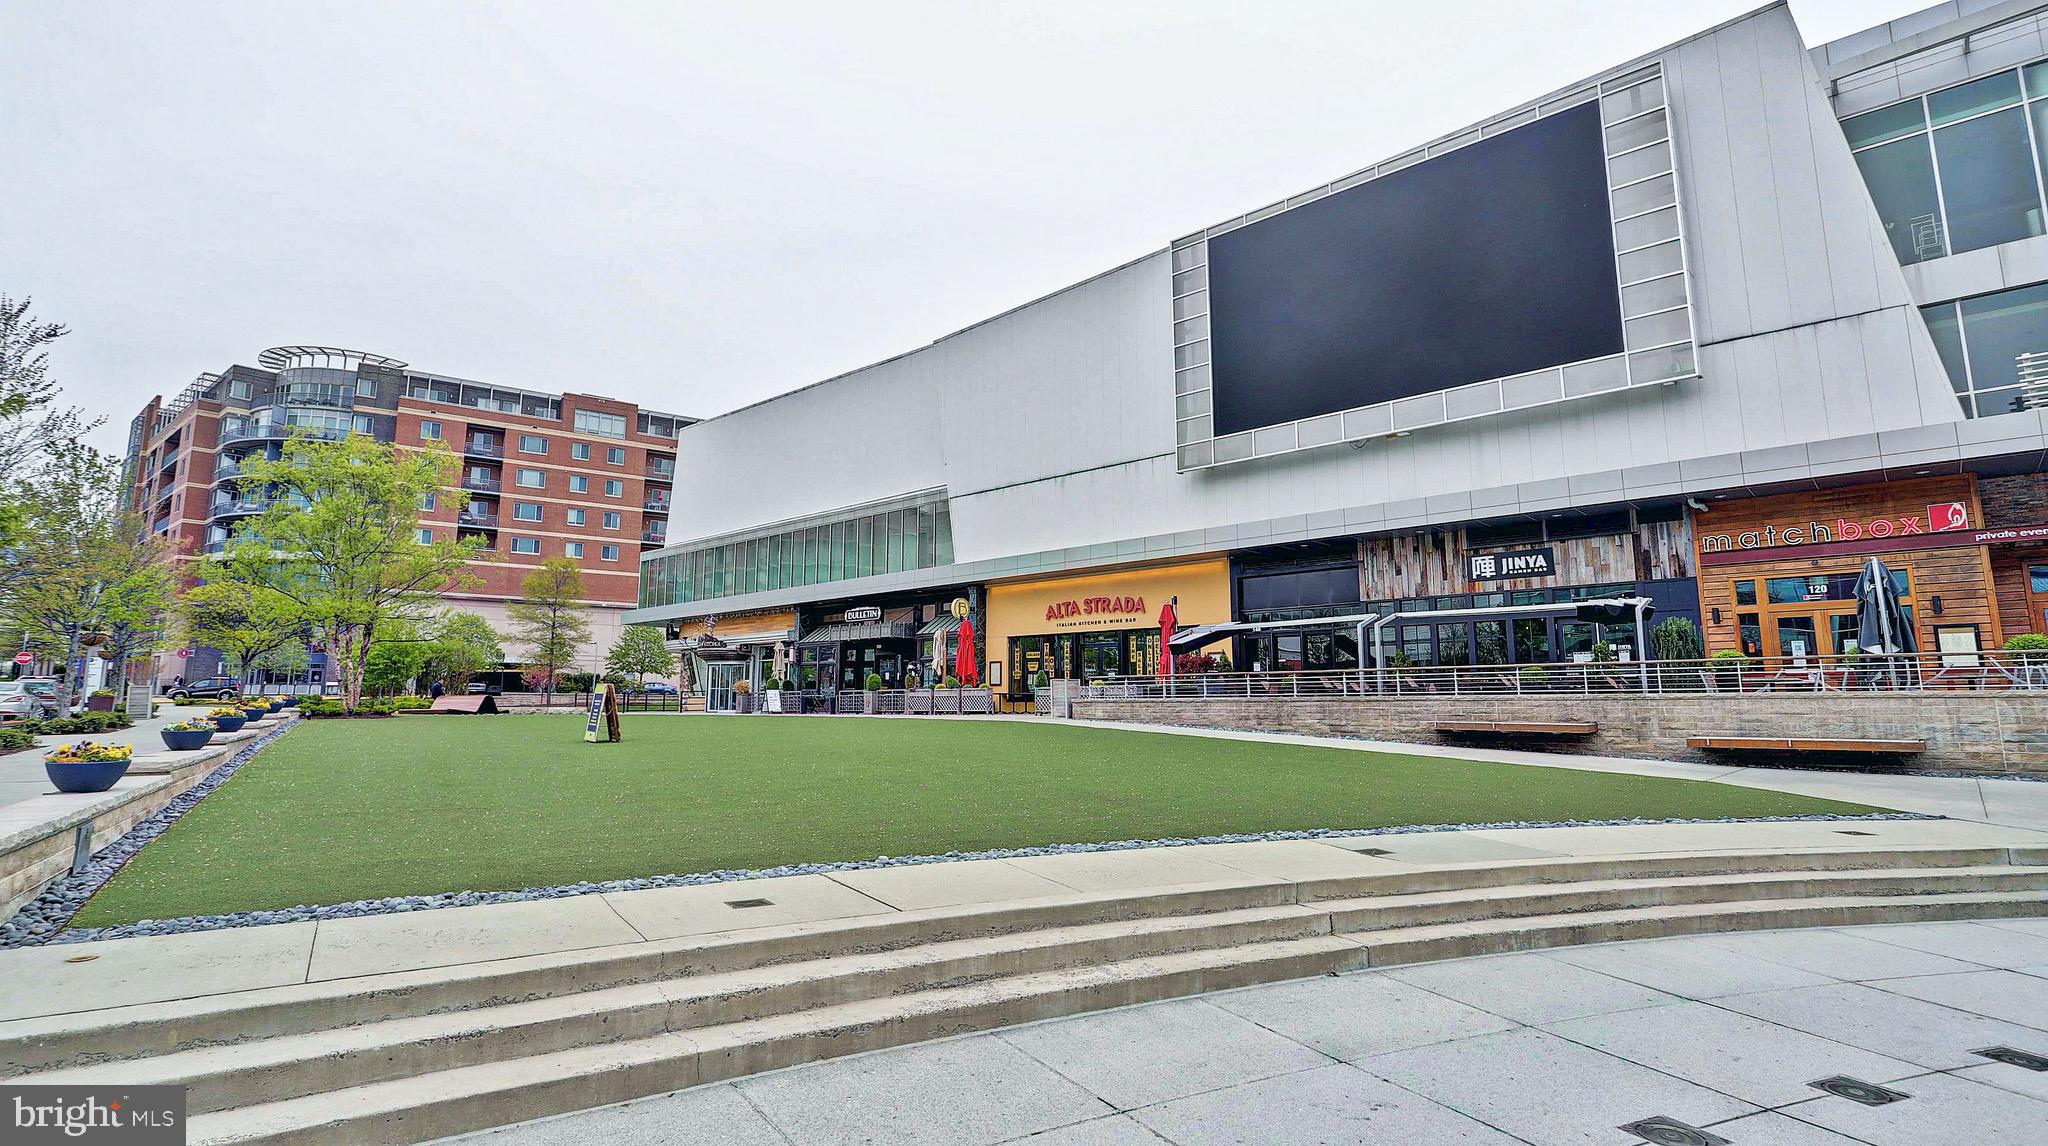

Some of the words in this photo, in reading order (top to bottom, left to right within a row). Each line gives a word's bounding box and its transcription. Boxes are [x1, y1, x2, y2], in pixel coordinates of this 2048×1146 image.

[1703, 516, 1922, 552] matchbox
[1975, 530, 2017, 541] private
[1501, 554, 1547, 575] JINYA
[1808, 585, 1827, 593] 120
[847, 609, 878, 620] BULLETIN
[1045, 600, 1081, 620] ALTA
[1083, 596, 1146, 615] STRADA
